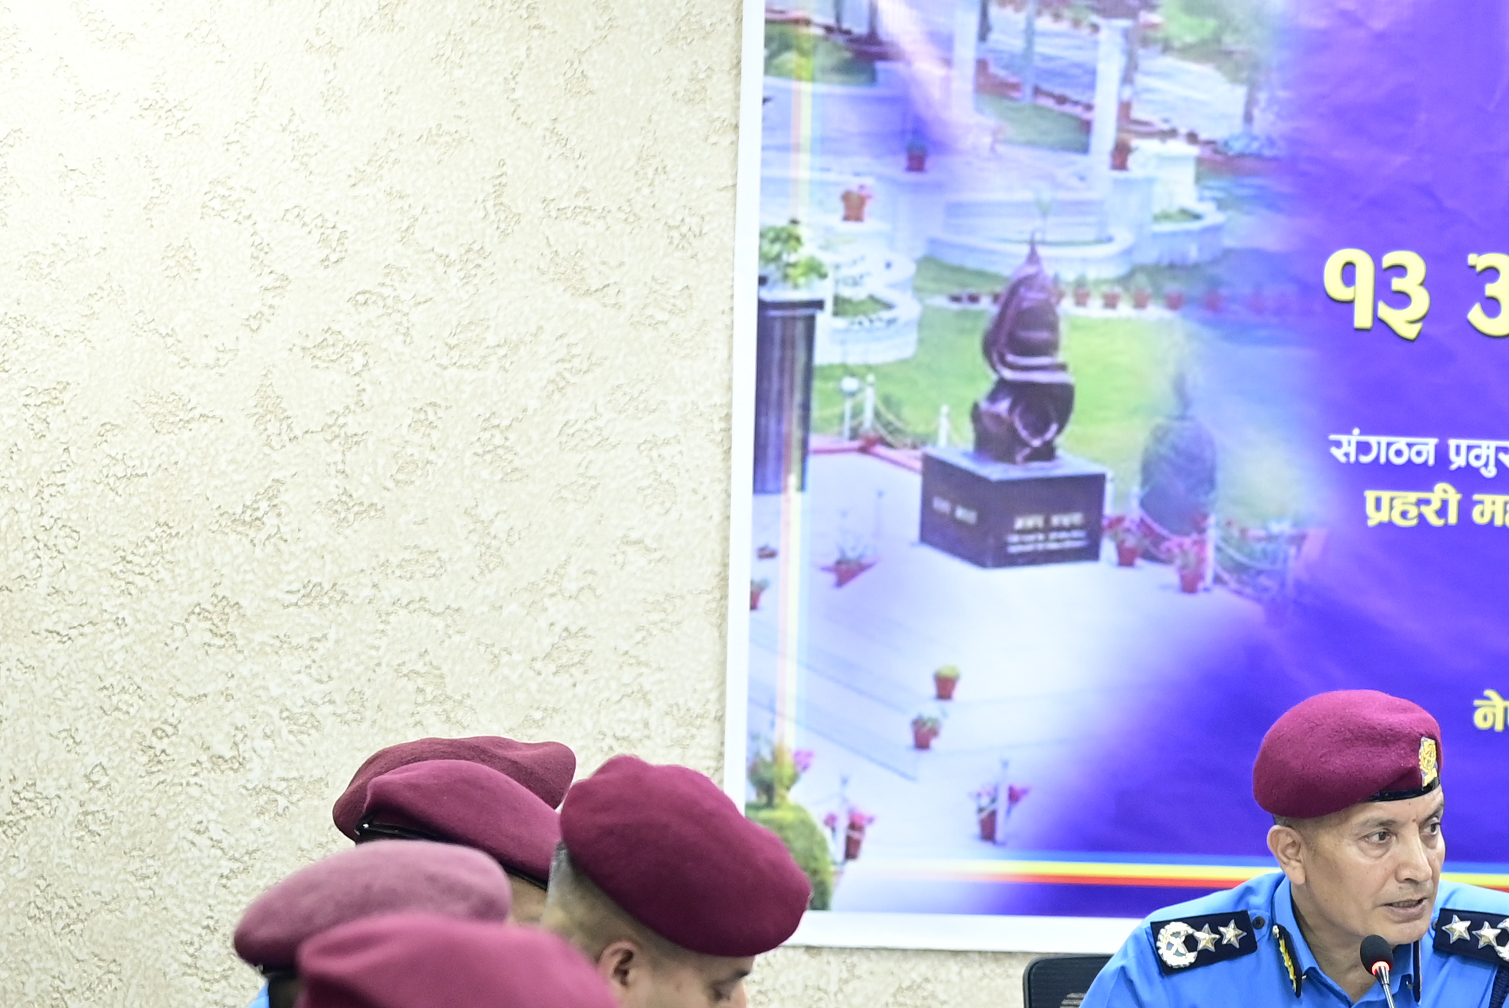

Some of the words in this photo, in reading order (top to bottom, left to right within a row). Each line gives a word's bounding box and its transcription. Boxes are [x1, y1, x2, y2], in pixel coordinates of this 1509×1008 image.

[1323, 246, 1430, 340] १३
[1329, 428, 1438, 466] संगठन
[1364, 483, 1462, 527] प्रहरी
